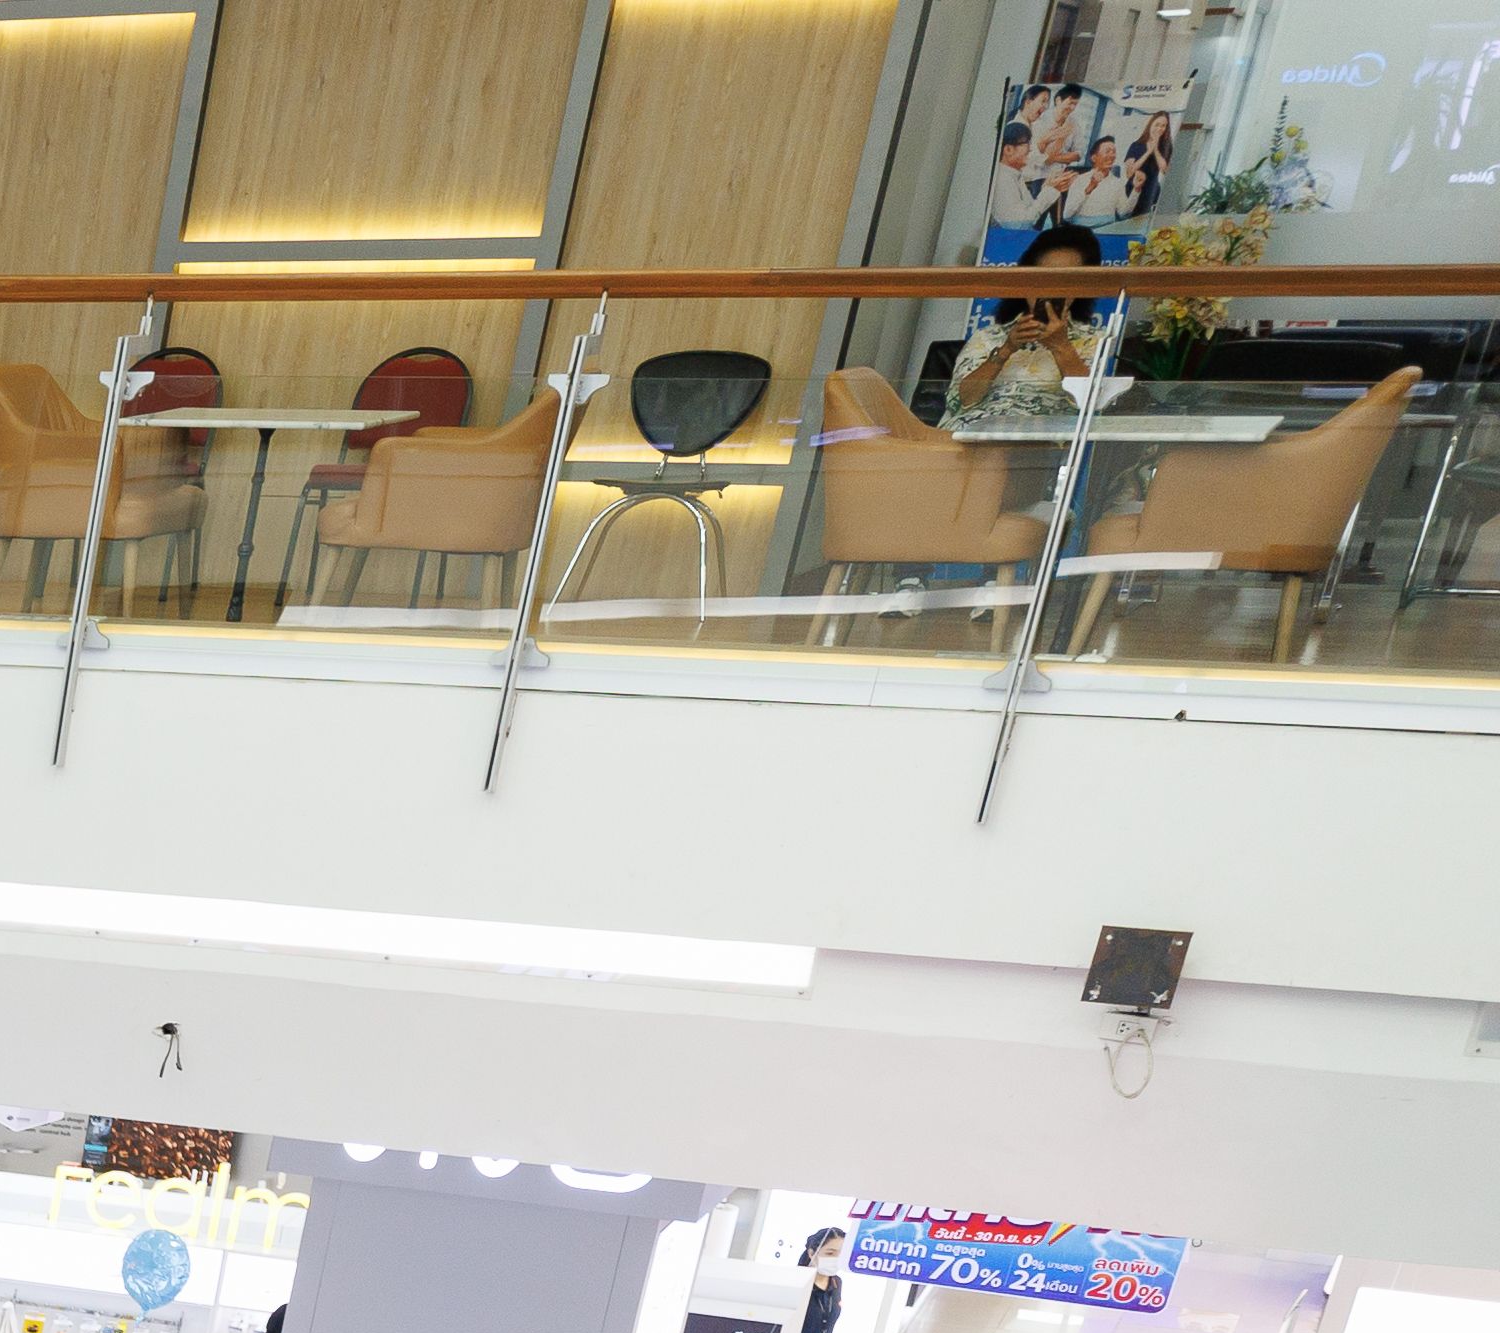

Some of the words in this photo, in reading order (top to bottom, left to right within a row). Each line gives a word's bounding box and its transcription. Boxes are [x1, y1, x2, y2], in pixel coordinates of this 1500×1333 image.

[48, 1162, 311, 1250] realm
[934, 1226, 966, 1241] วันนี้
[974, 1229, 992, 1242] 30
[994, 1231, 1018, 1244] ก.ย.
[1021, 1234, 1042, 1246] 67
[853, 1254, 922, 1279] ลดมาก
[930, 1255, 1003, 1290] 70%
[1016, 1253, 1046, 1270] 0%
[1094, 1257, 1160, 1278] ลดเพิ่ม
[1008, 1270, 1044, 1293] 24
[1084, 1272, 1164, 1307] 20%
